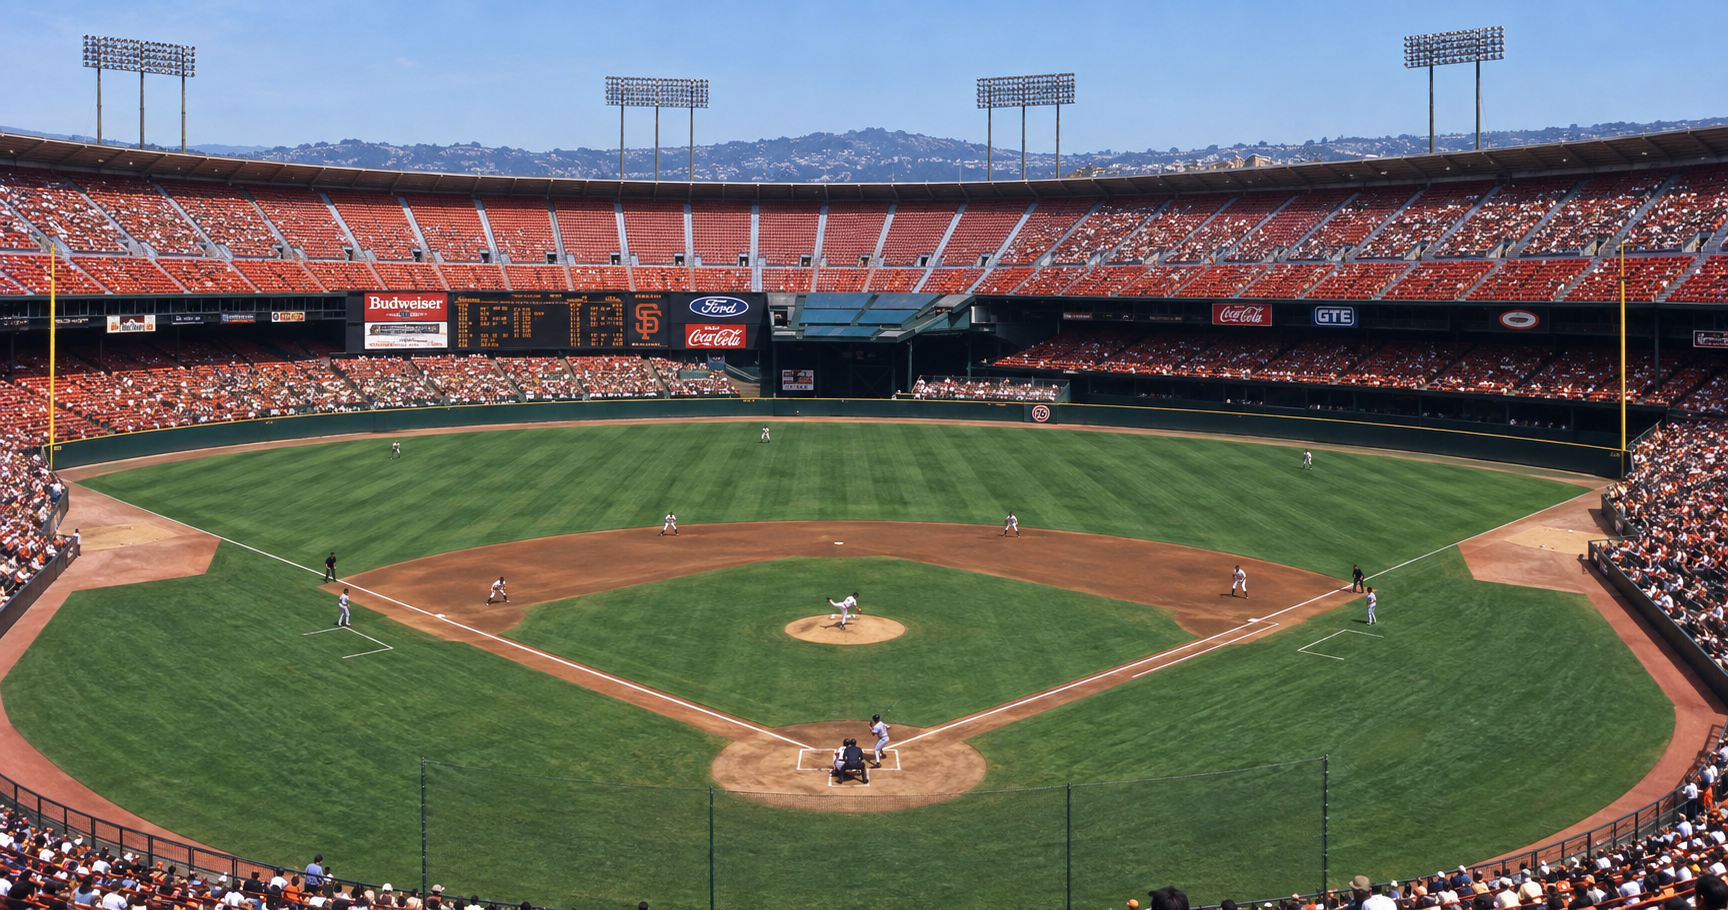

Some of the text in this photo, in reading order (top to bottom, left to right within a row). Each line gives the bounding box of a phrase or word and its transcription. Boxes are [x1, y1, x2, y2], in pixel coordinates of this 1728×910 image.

[369, 296, 443, 310] Budweiser
[701, 299, 737, 314] Ford
[635, 303, 662, 340] SF
[1317, 309, 1351, 323] GTE
[1036, 409, 1046, 418] 76
